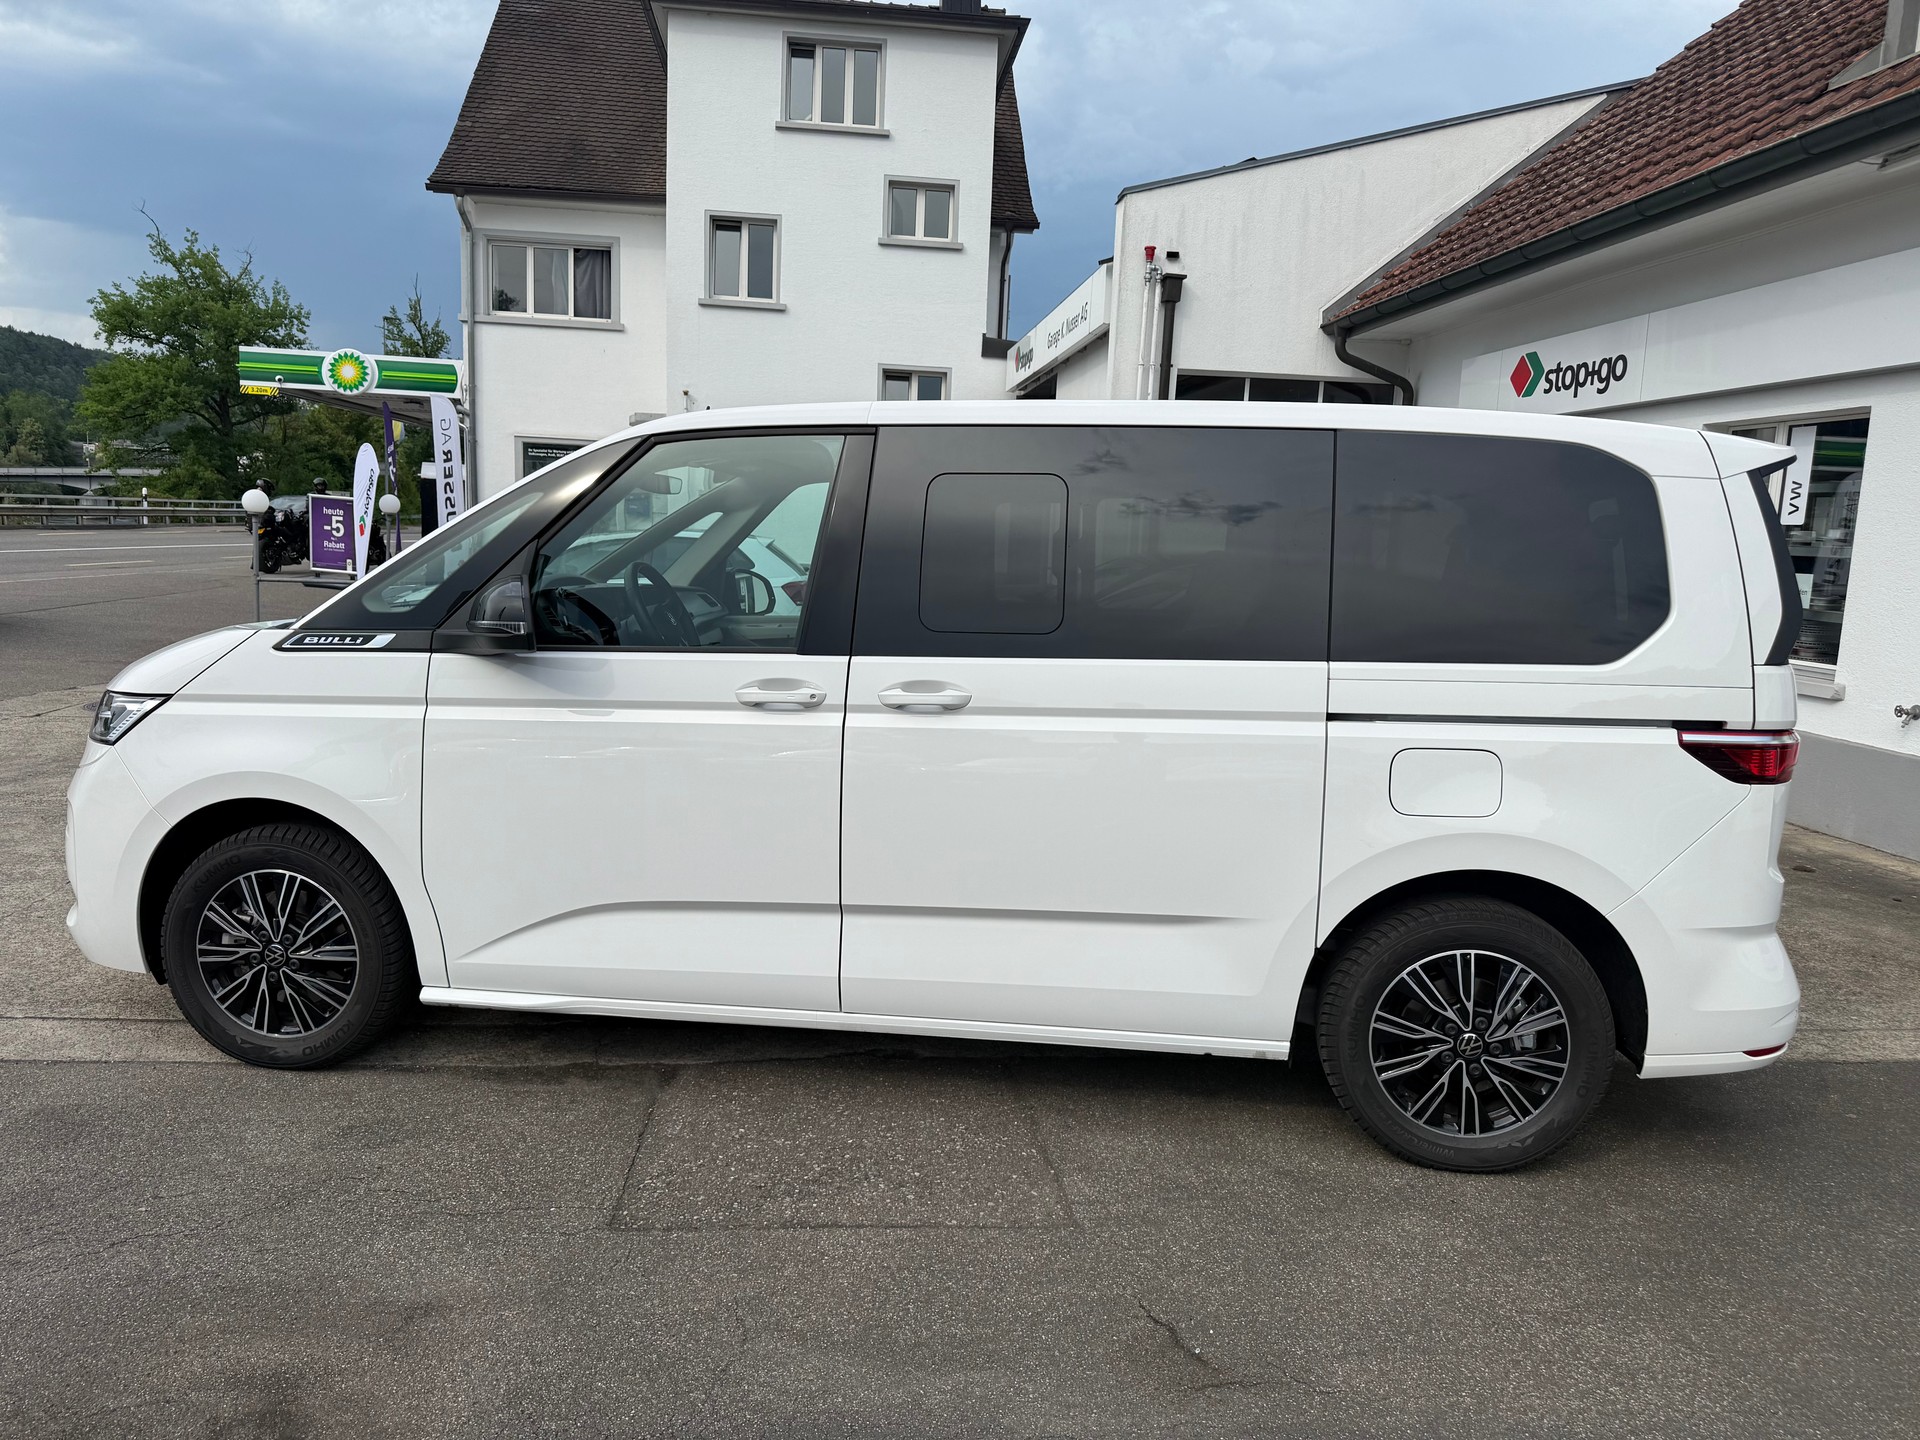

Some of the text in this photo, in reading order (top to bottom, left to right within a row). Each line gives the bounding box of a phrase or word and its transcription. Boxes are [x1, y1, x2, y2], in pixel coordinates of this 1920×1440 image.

[1543, 354, 1628, 398] stop+go
[1788, 480, 1803, 516] VW
[323, 506, 344, 516] heute
[323, 540, 345, 549] Rabatt
